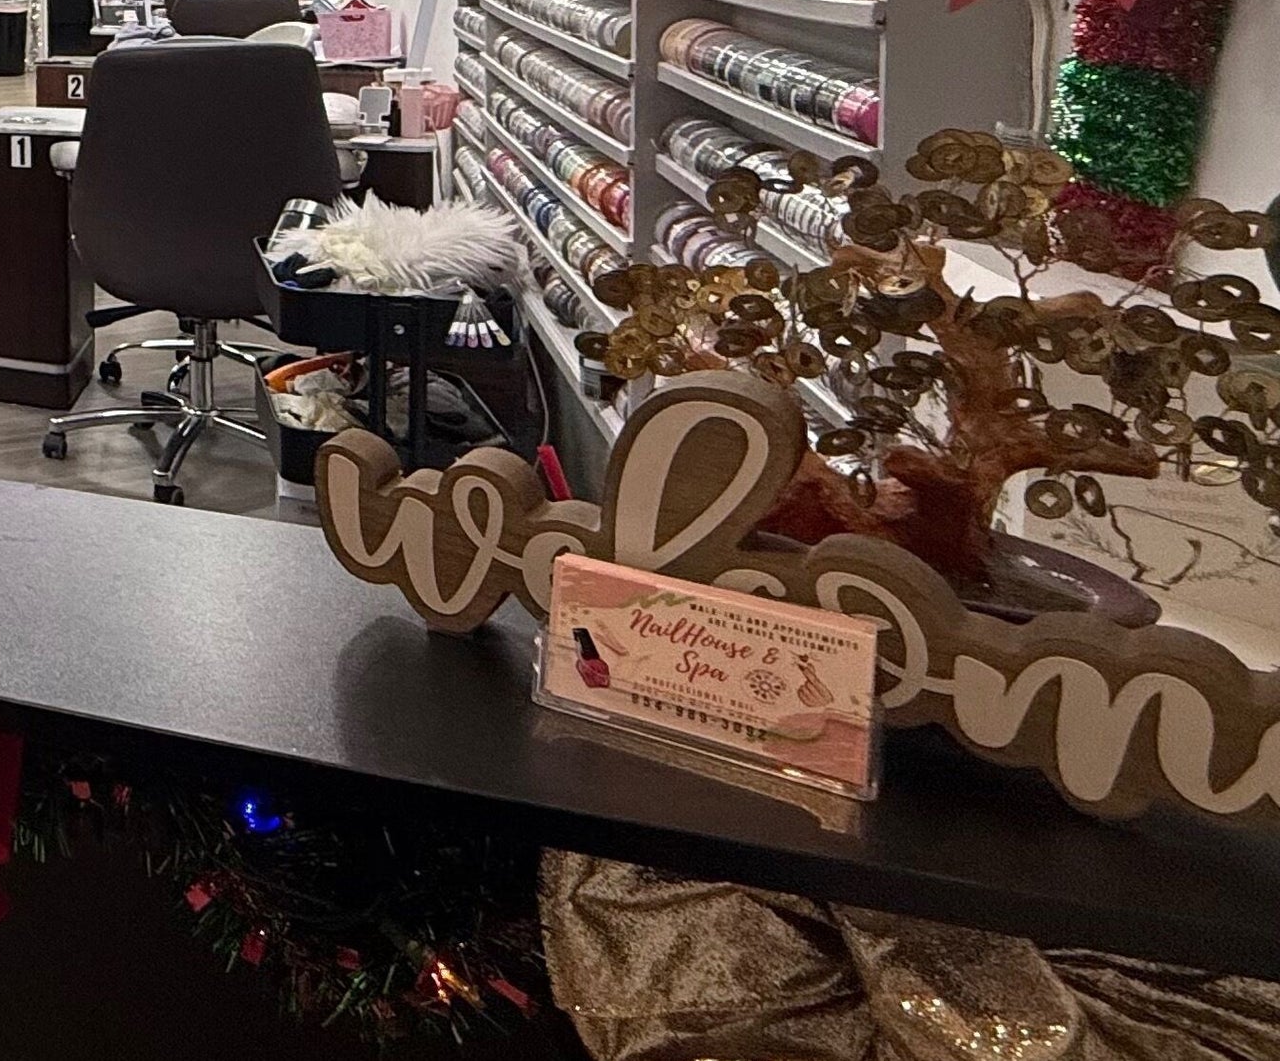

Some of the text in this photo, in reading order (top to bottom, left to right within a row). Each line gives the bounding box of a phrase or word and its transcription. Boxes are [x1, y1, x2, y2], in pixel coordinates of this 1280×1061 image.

[70, 76, 82, 98] 2
[16, 137, 26, 166] 1
[629, 608, 780, 665] NailHouse &
[708, 617, 727, 628] ARE
[732, 623, 775, 640] ALWAYS
[746, 617, 768, 629] AND
[773, 623, 859, 651] APPOINTMENTS
[675, 650, 729, 683] Spa
